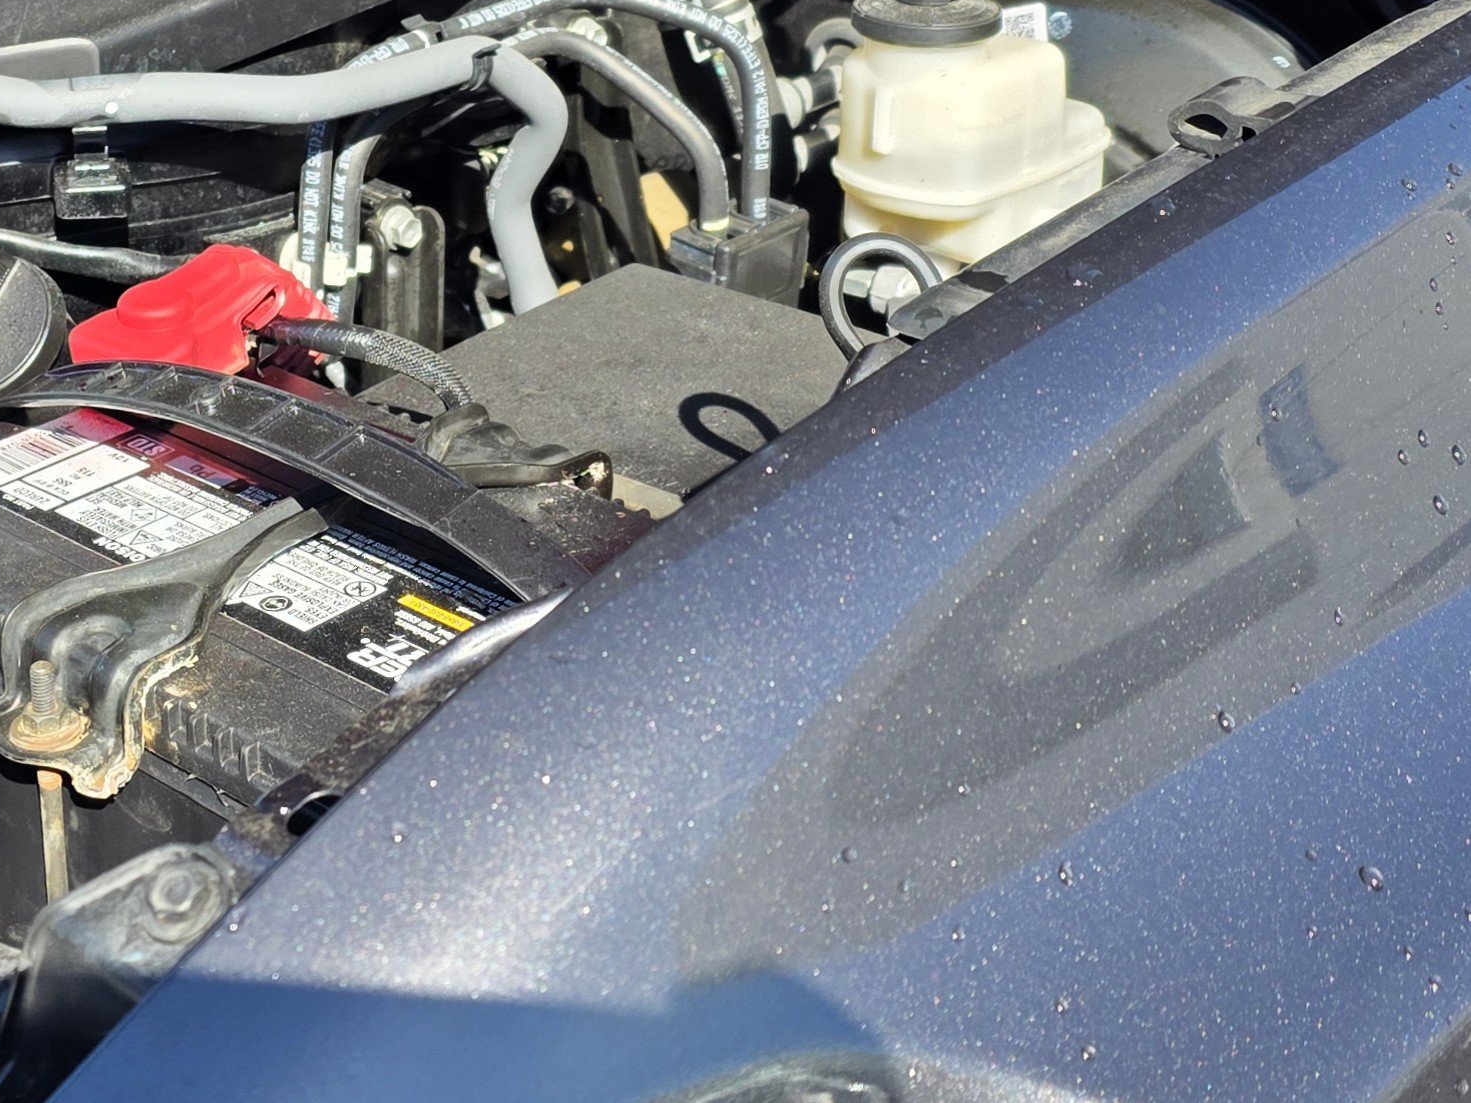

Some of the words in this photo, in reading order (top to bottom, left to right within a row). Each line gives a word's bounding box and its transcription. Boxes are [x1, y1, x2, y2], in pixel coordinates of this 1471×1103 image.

[126, 437, 166, 455] STD
[184, 463, 216, 478] Pb
[93, 536, 148, 562] OISON
